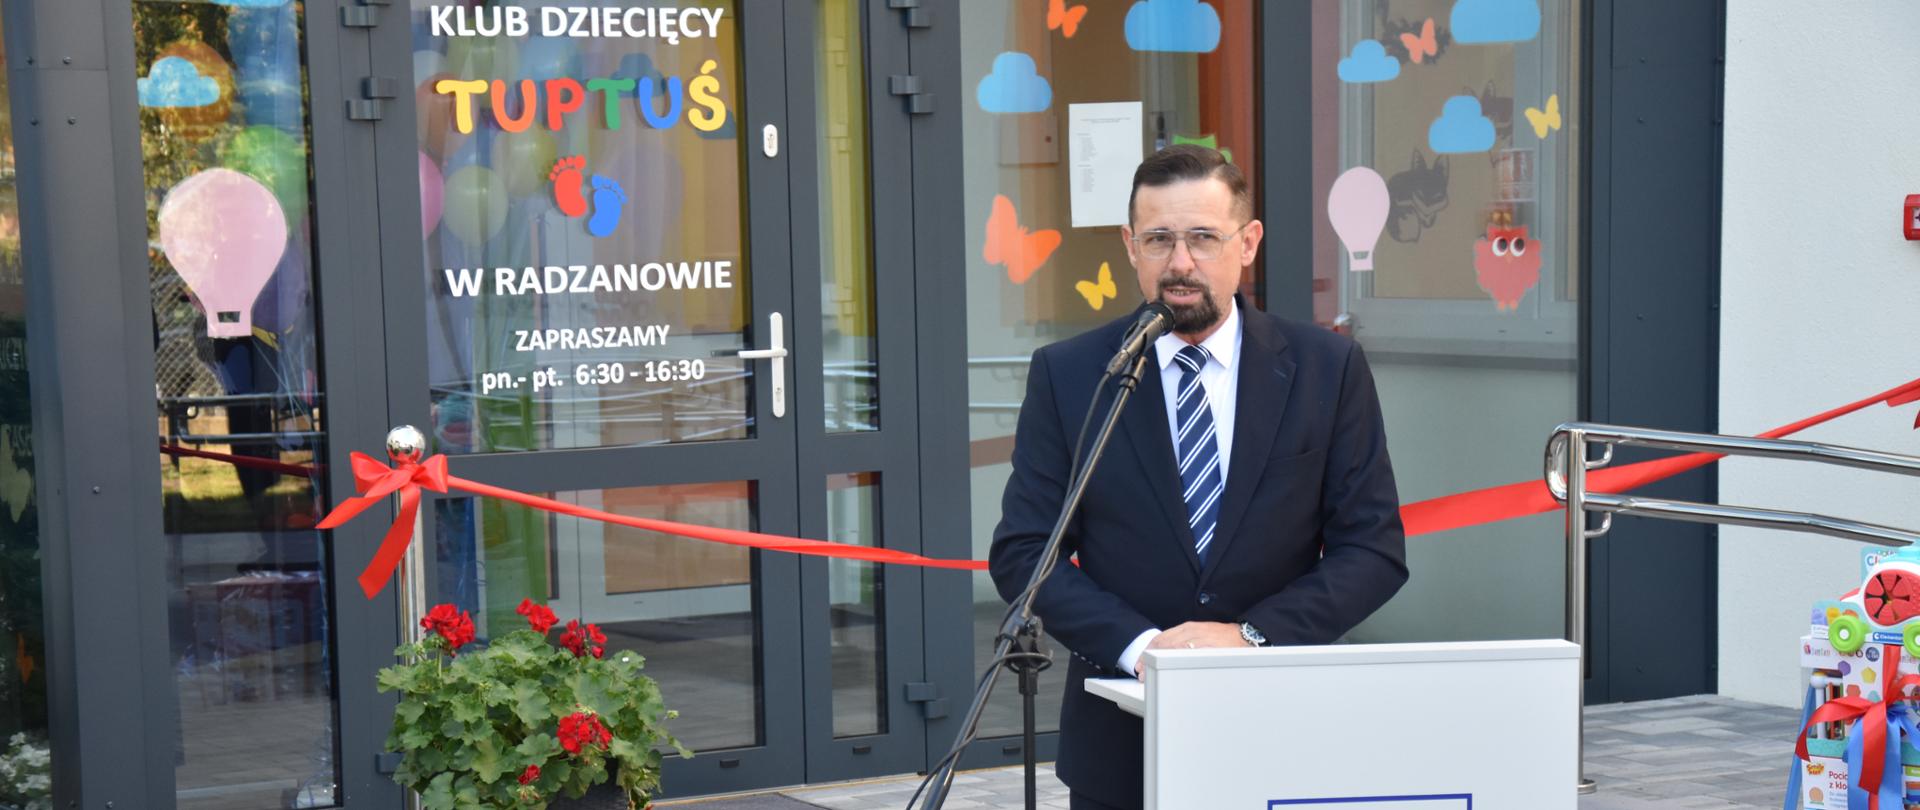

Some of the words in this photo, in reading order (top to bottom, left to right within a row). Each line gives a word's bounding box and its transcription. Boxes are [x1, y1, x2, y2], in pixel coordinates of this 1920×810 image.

[430, 6, 529, 37] KLUB
[541, 7, 724, 44] DZIECIĘCY
[435, 59, 727, 135] TUPTUŚ
[445, 268, 484, 297] W
[495, 261, 732, 296] RADZANOWIE
[515, 324, 670, 352] ZAPRASZAMY
[533, 367, 563, 393] pt.
[575, 362, 625, 385] 6:30
[645, 358, 706, 382] 16:30
